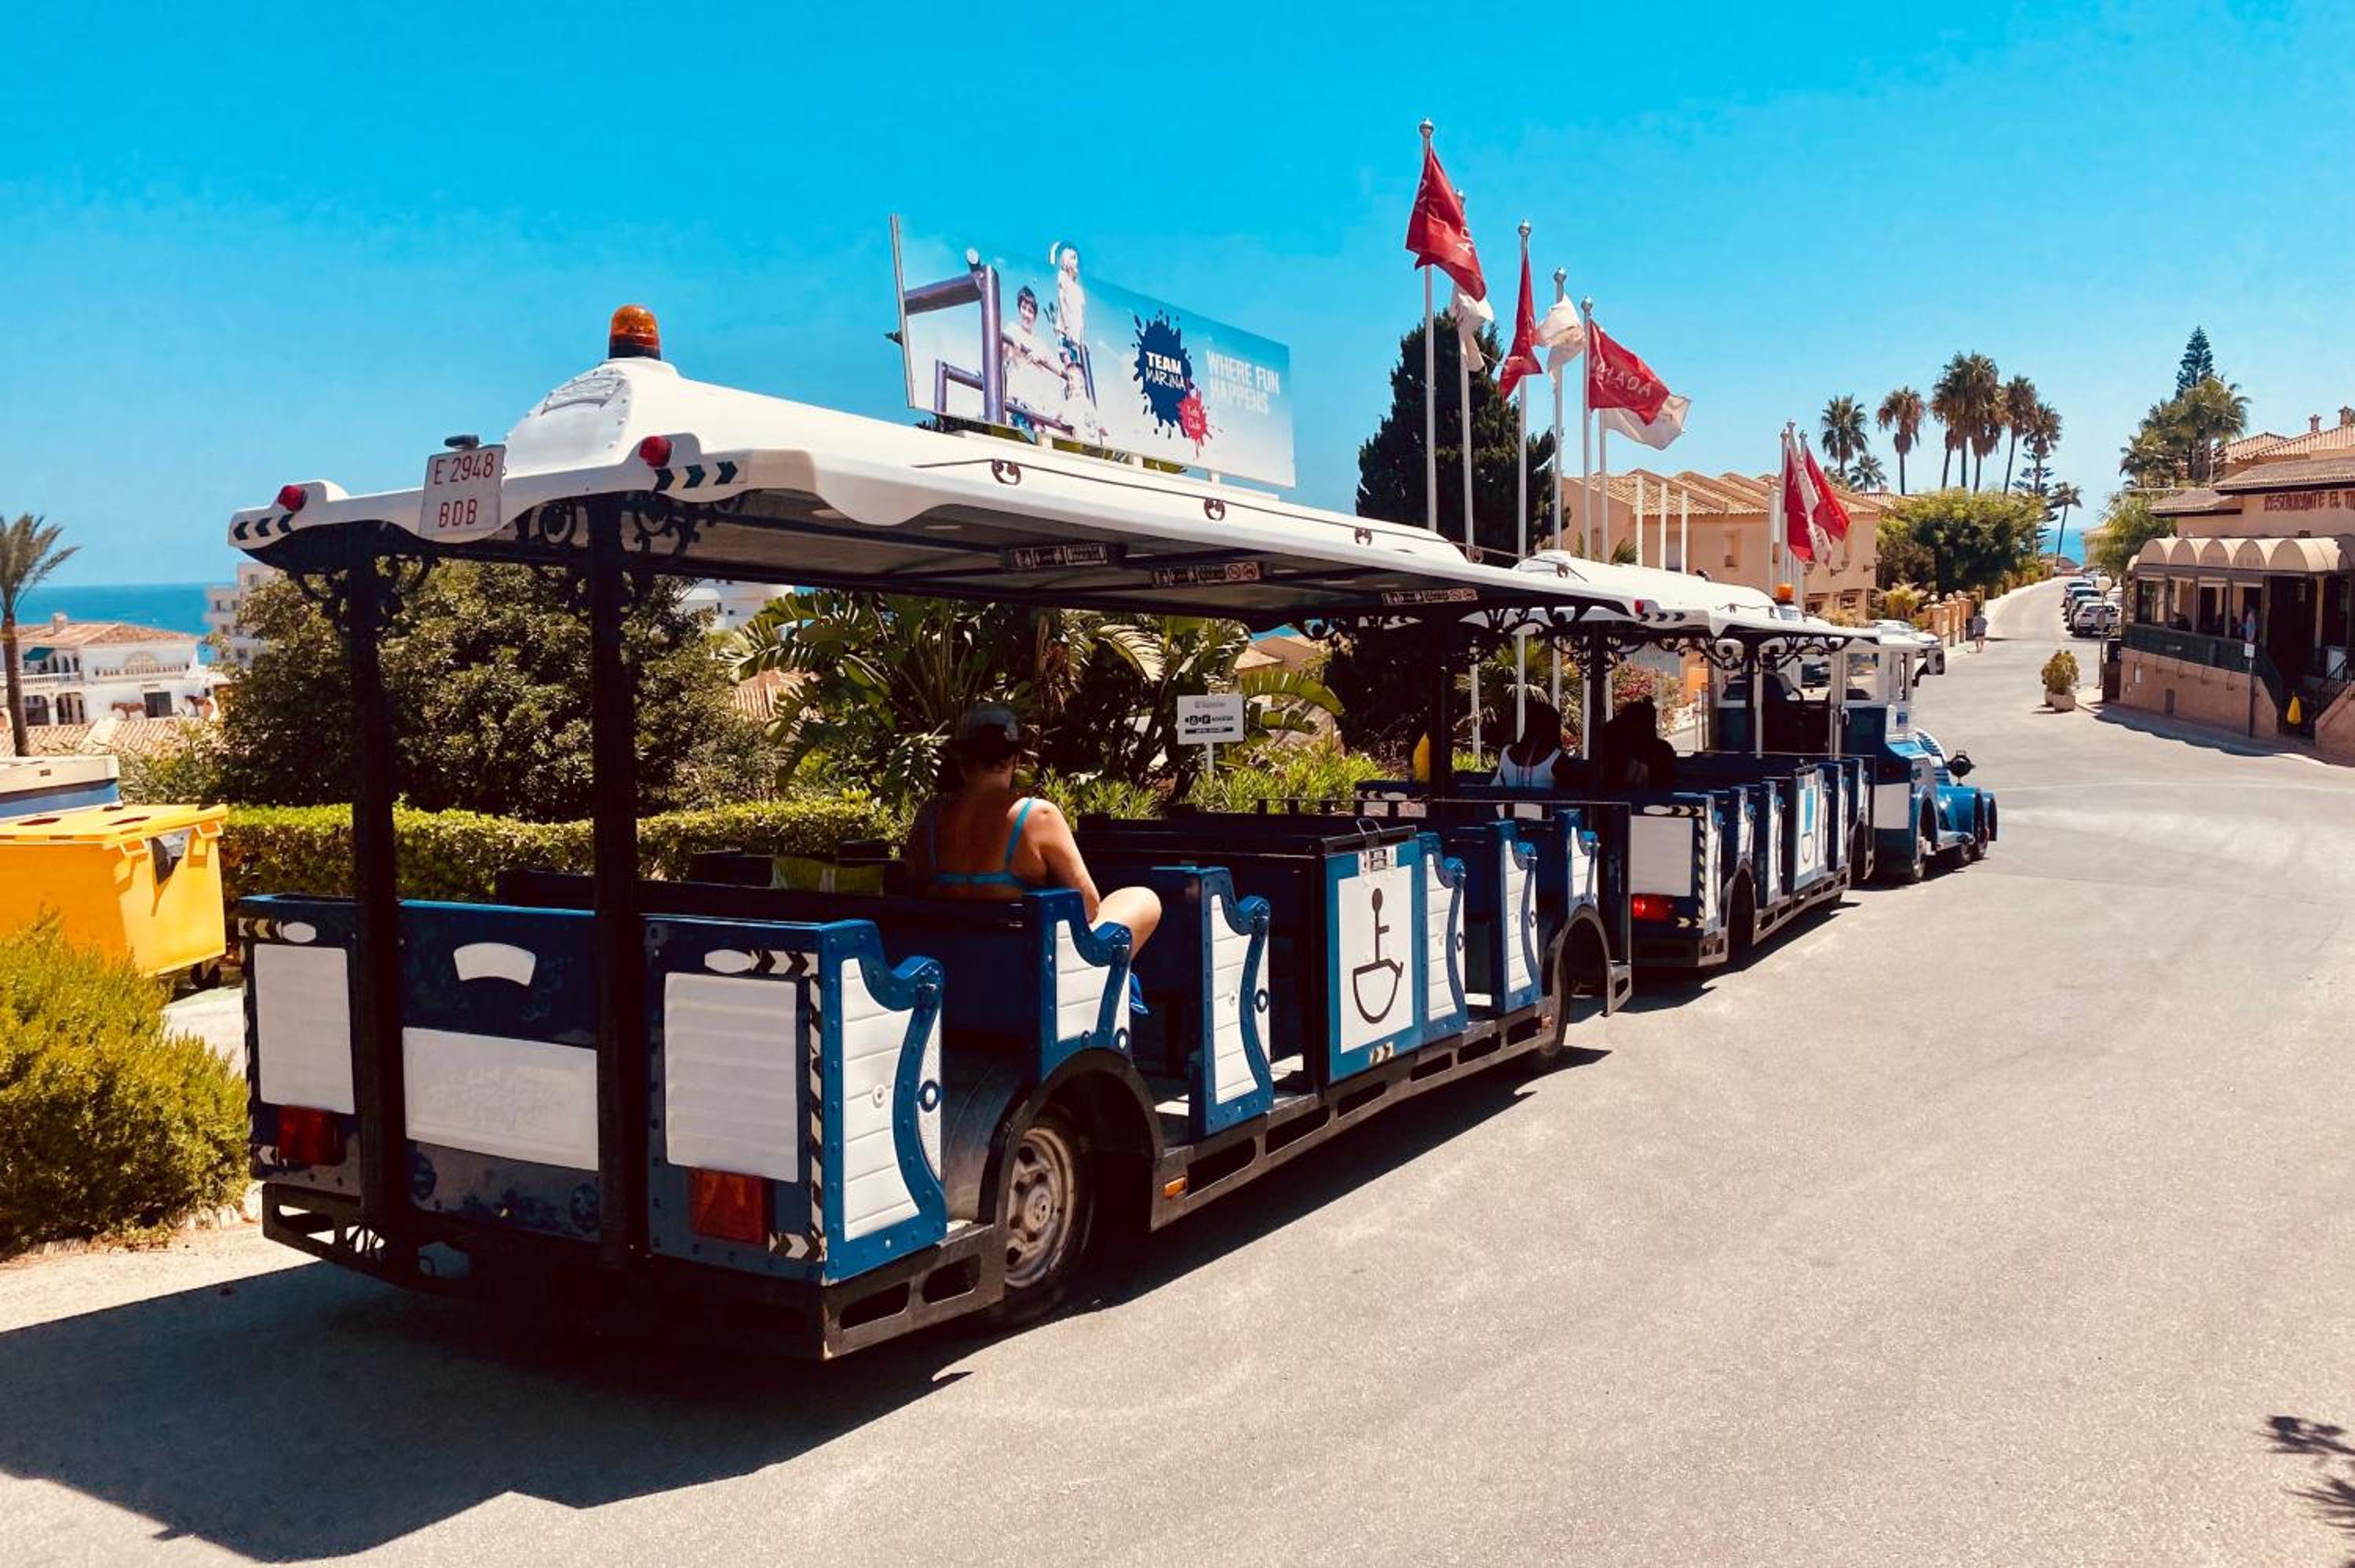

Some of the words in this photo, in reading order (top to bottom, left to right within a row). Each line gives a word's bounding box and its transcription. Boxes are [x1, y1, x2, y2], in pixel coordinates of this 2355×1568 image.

[1146, 352, 1181, 374] TEAM
[1206, 351, 1252, 386] WHERE
[1256, 366, 1280, 396] FUN
[434, 459, 447, 485] E
[450, 451, 495, 483] 2948
[2264, 491, 2325, 512] RESTAURANTE
[2329, 490, 2342, 509] EL
[103, 669, 121, 677] BAR
[125, 665, 182, 676] RESTAURANTE
